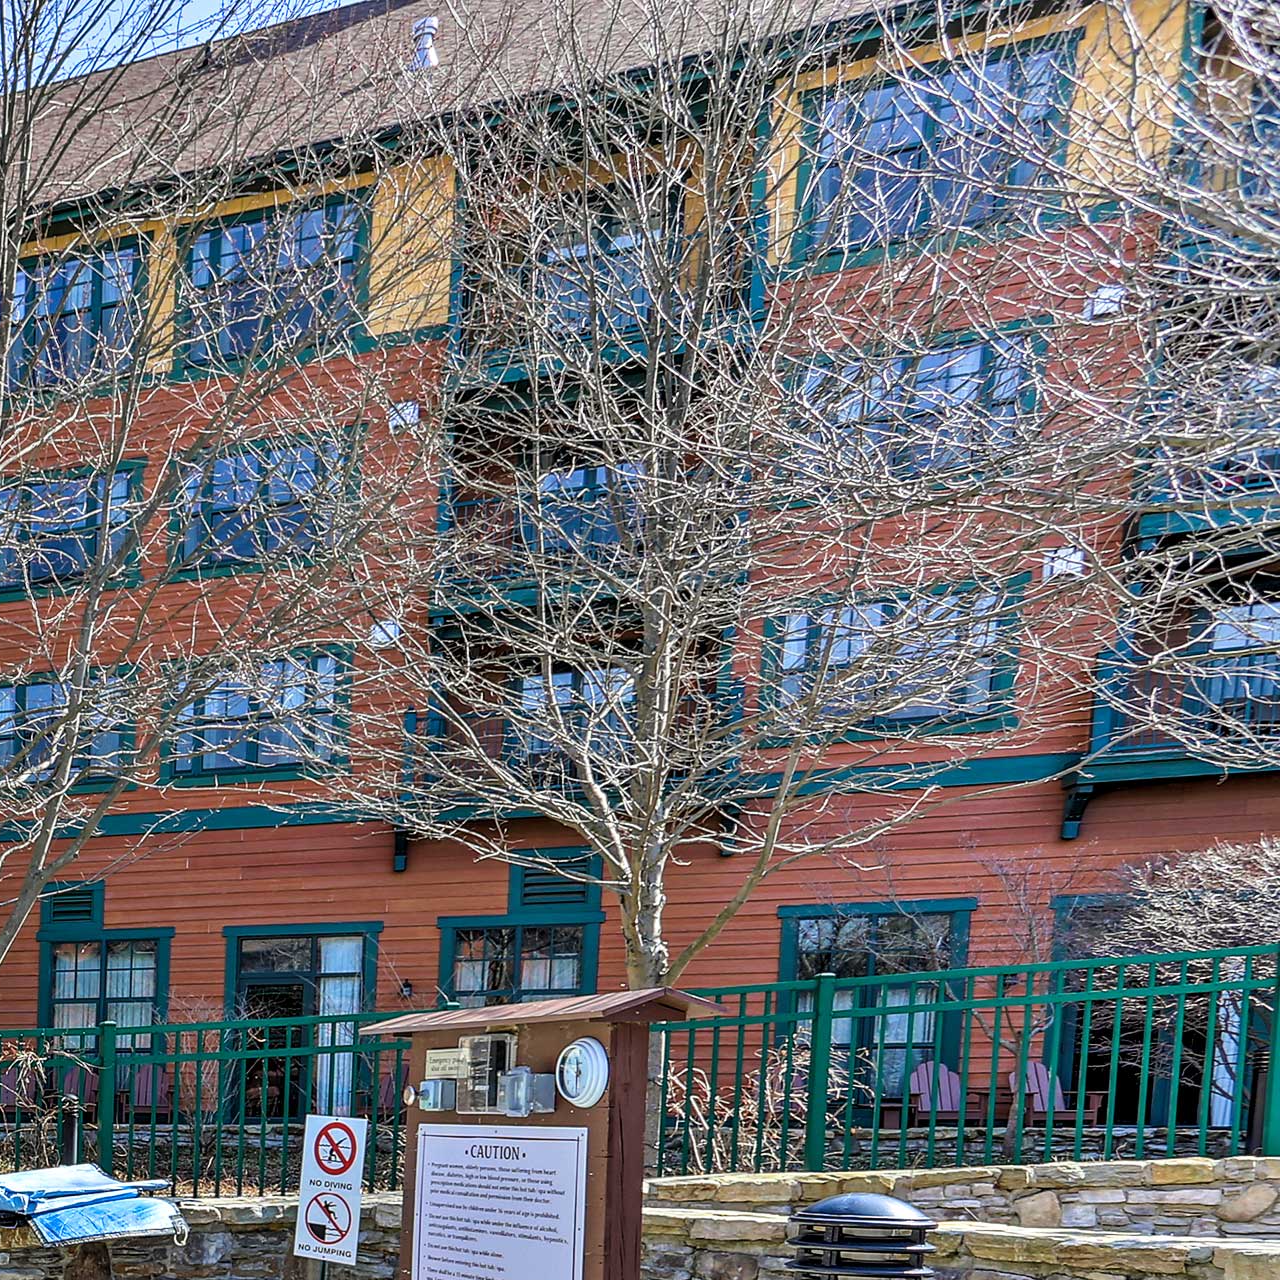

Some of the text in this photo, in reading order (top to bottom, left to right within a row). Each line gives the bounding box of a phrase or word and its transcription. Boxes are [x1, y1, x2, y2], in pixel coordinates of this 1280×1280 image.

[470, 1144, 519, 1160] CAUTION
[309, 1179, 352, 1190] NO DIVING
[298, 1243, 352, 1257] NO JUMPING
